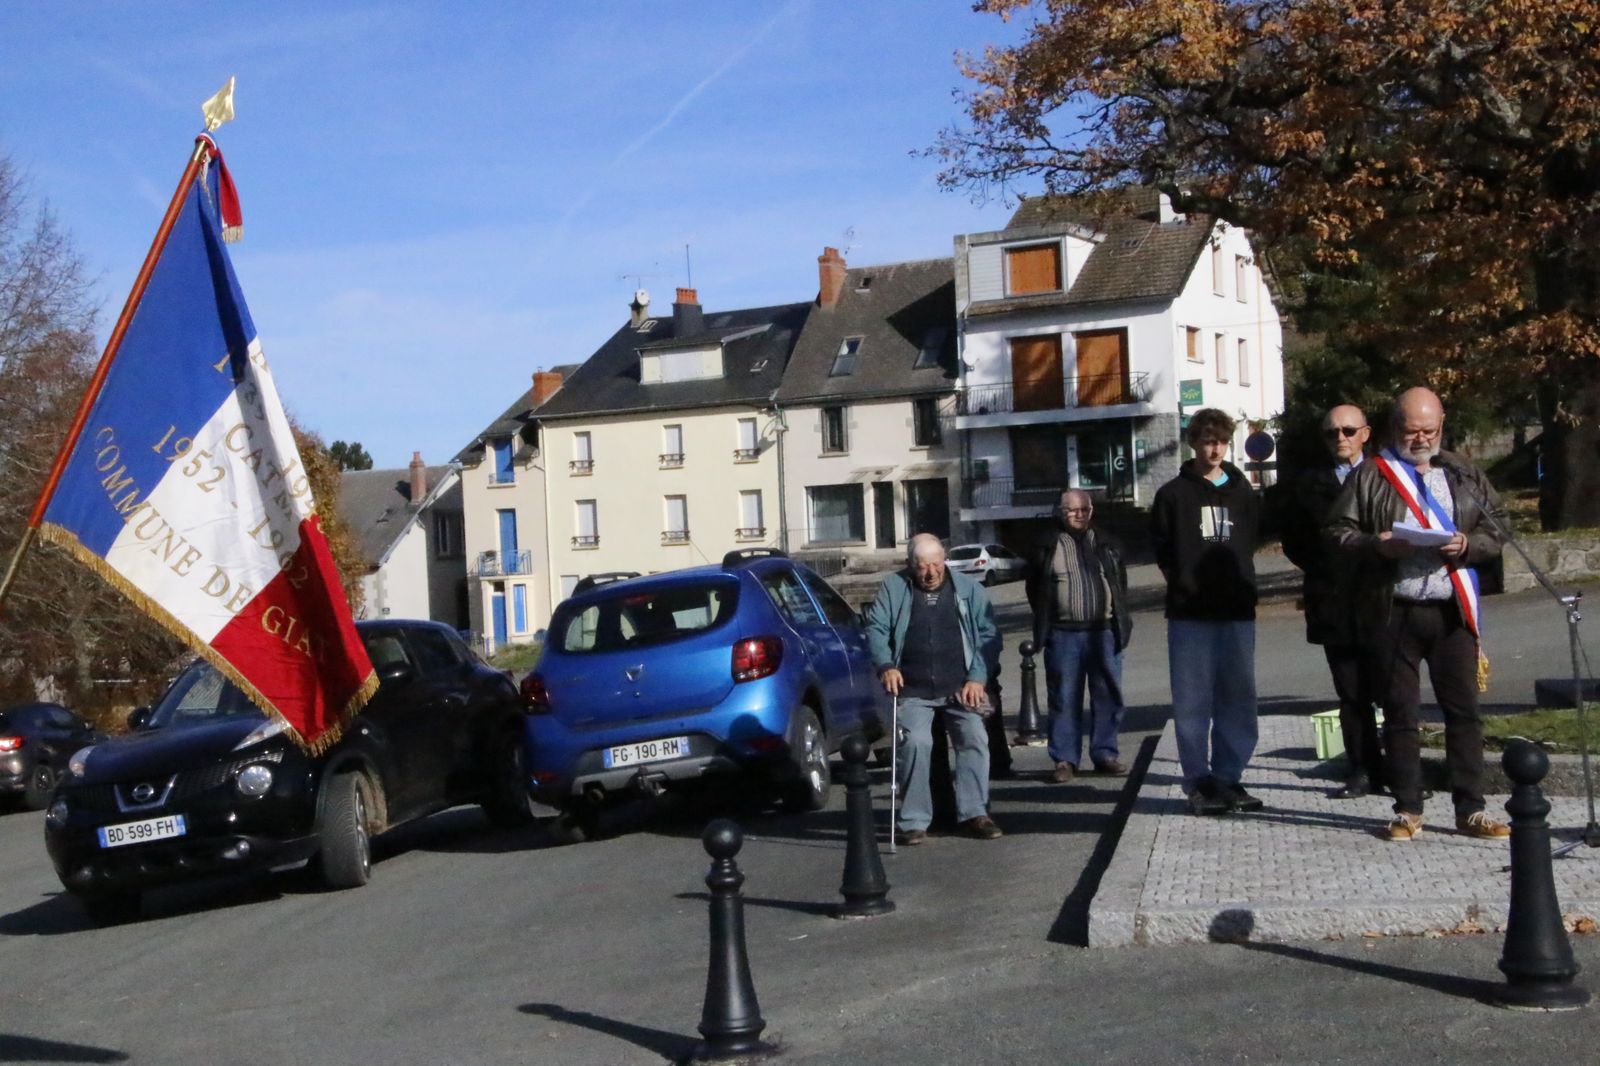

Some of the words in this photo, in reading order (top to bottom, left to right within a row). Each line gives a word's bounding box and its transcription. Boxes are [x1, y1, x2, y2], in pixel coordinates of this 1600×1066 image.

[95, 426, 203, 578] COMMUNE
[200, 565, 253, 616] DE
[152, 424, 226, 493] 1952
[247, 516, 309, 589] 1962
[108, 820, 174, 843] BD-599-FH
